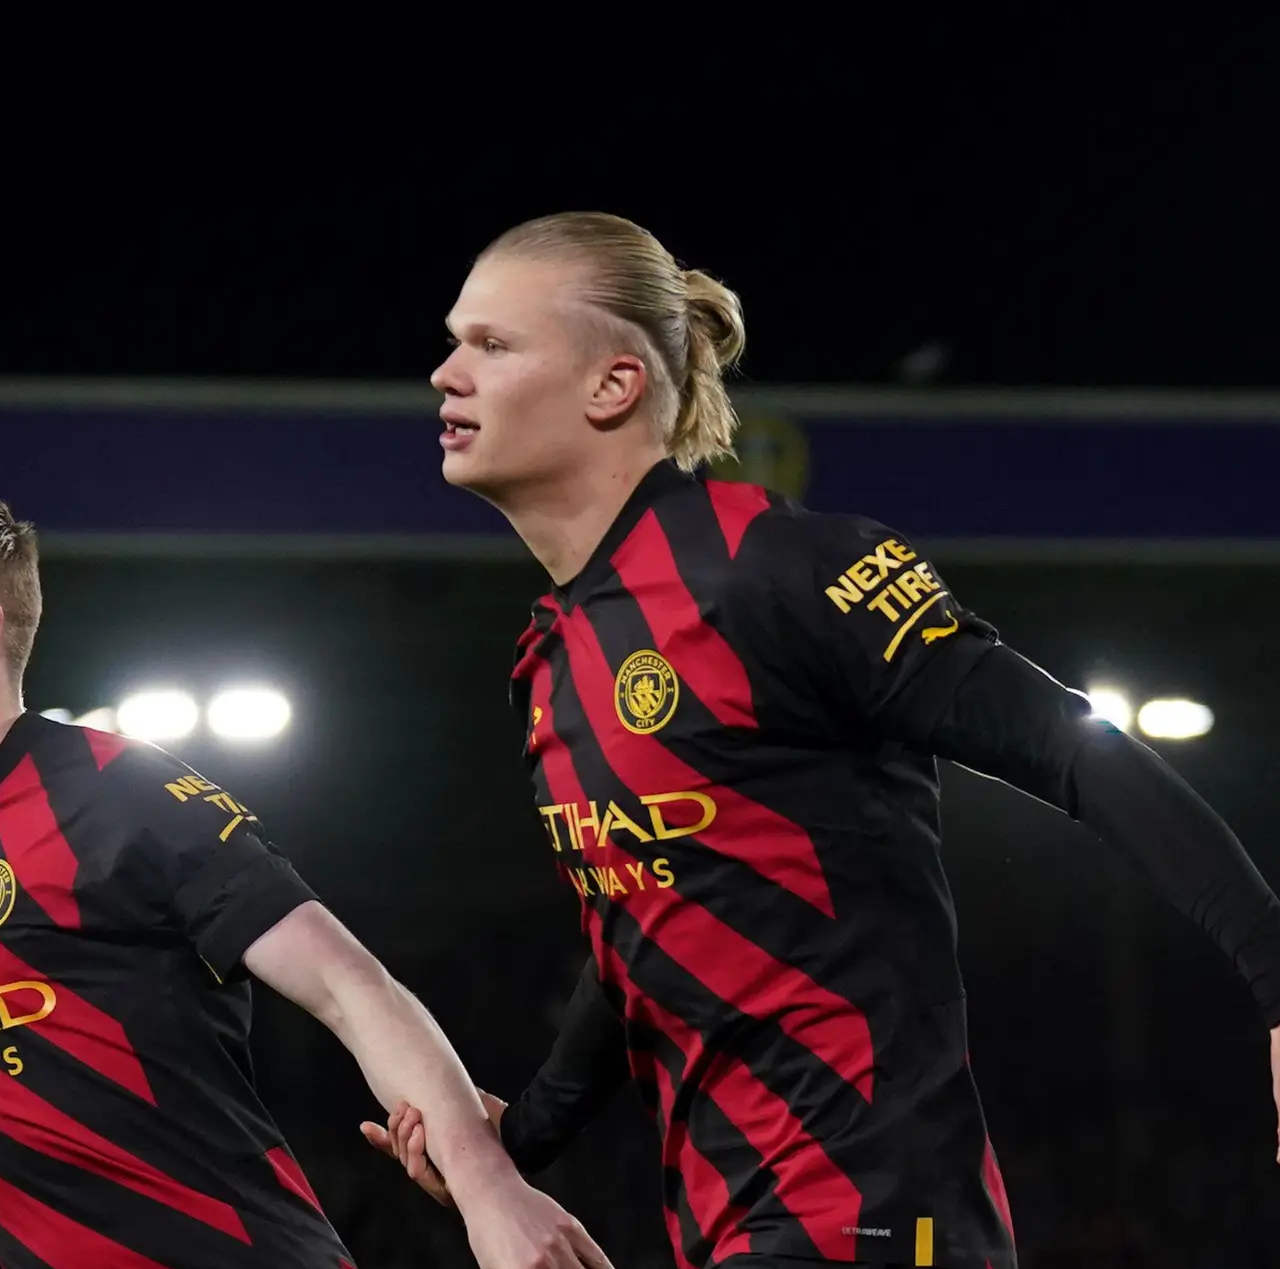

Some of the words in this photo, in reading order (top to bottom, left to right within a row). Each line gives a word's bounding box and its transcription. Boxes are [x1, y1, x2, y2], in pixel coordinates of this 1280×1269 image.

[866, 561, 941, 623] TIRE
[621, 656, 672, 685] MANCHESTER
[635, 718, 655, 728] CITY
